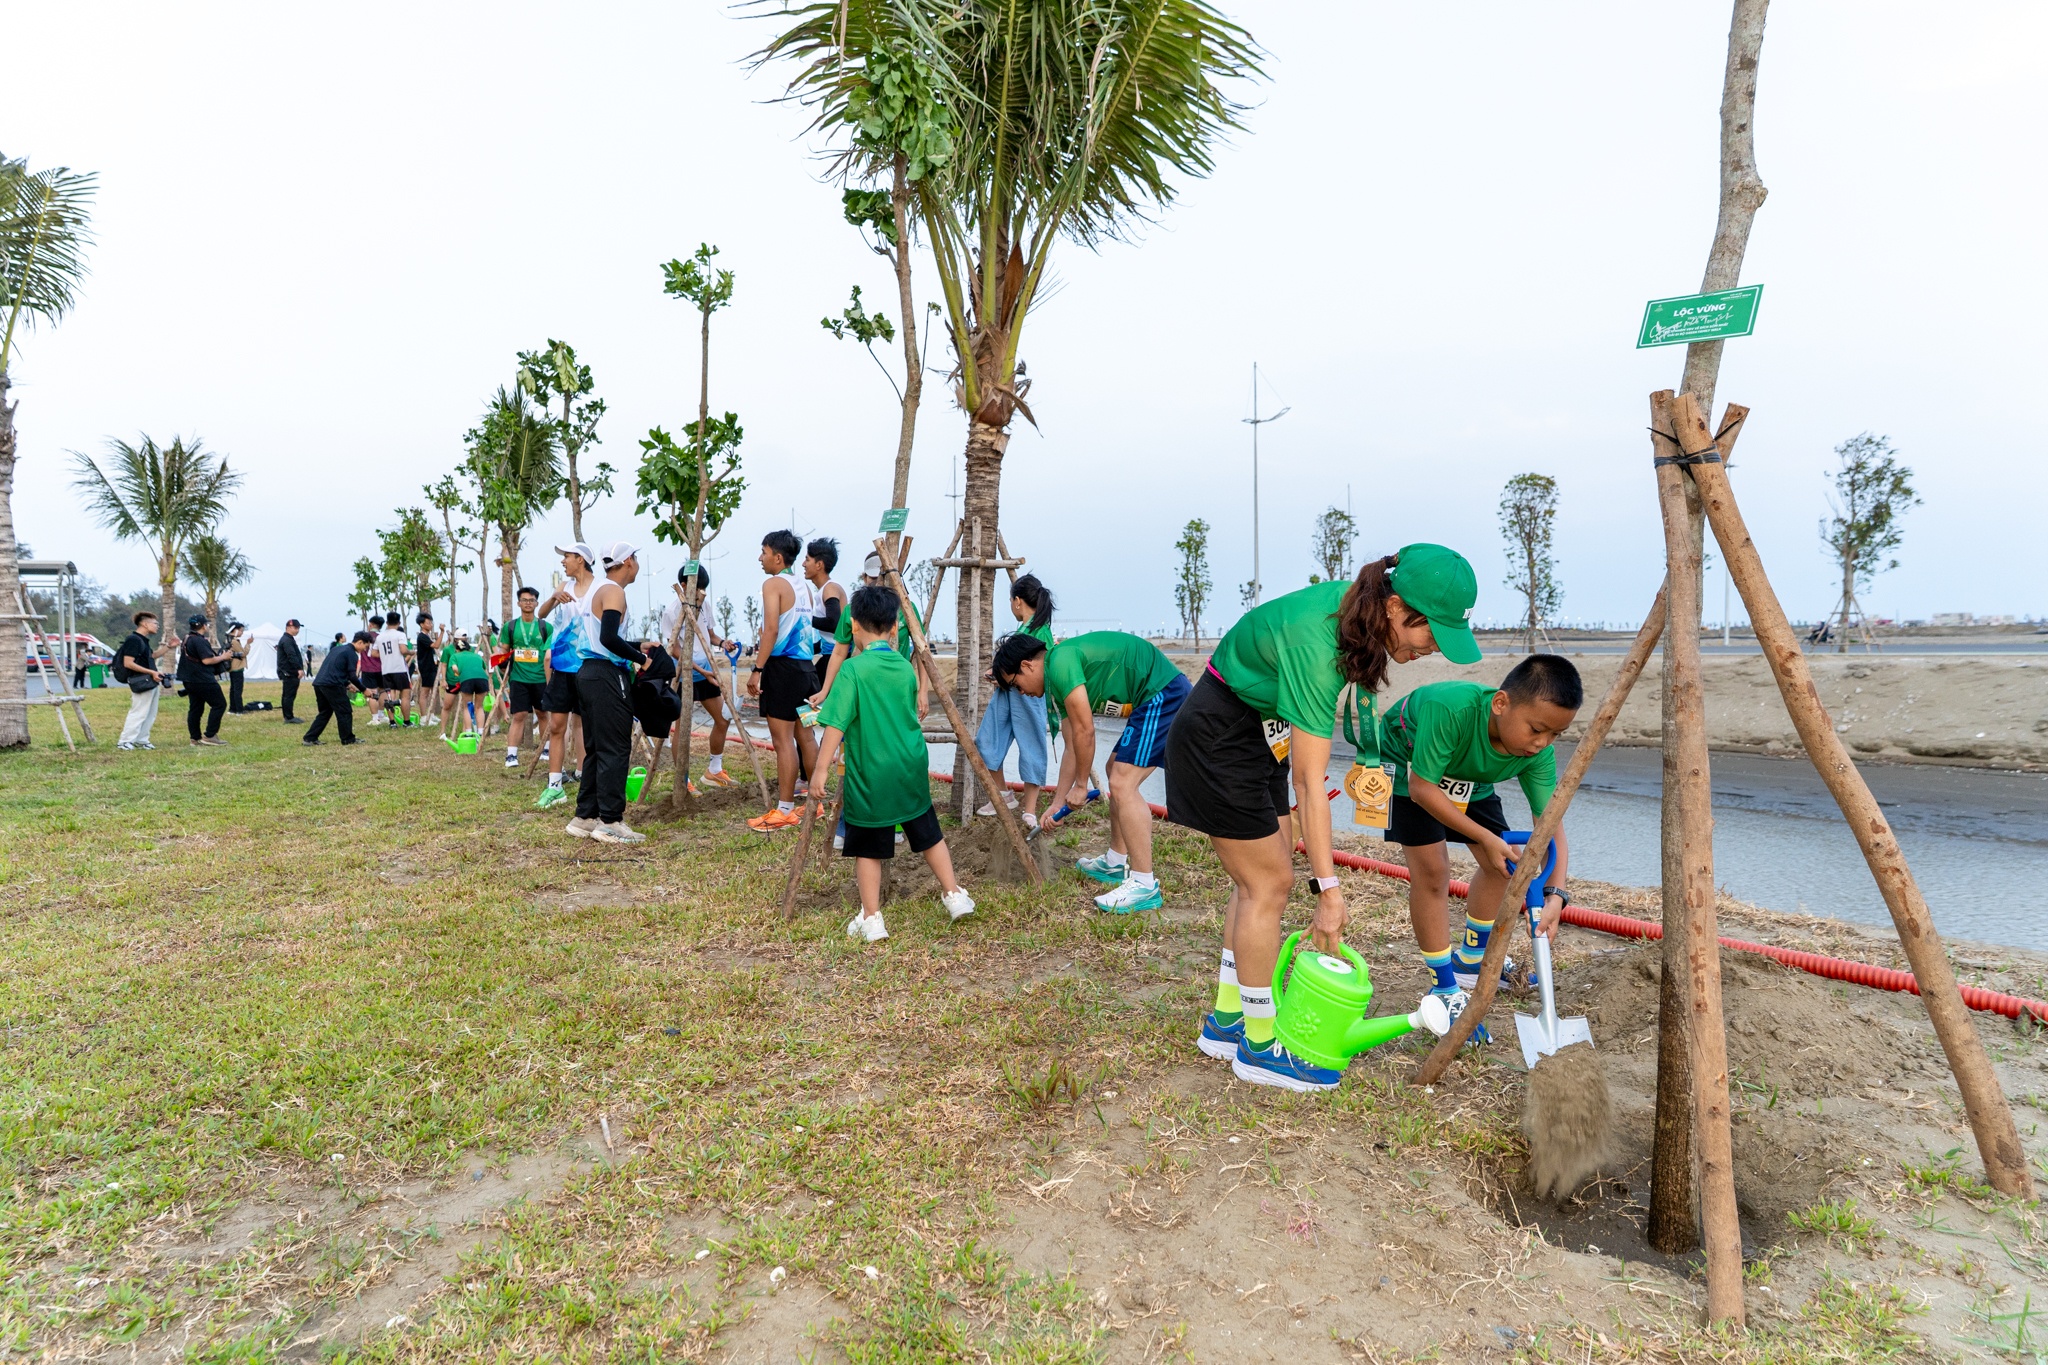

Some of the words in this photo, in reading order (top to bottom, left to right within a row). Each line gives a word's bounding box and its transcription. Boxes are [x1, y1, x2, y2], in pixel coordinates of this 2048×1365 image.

[1673, 307, 1694, 317] LỘC
[1696, 303, 1726, 314] VỪNG
[382, 641, 392, 655] 19
[1121, 726, 1134, 746] 8
